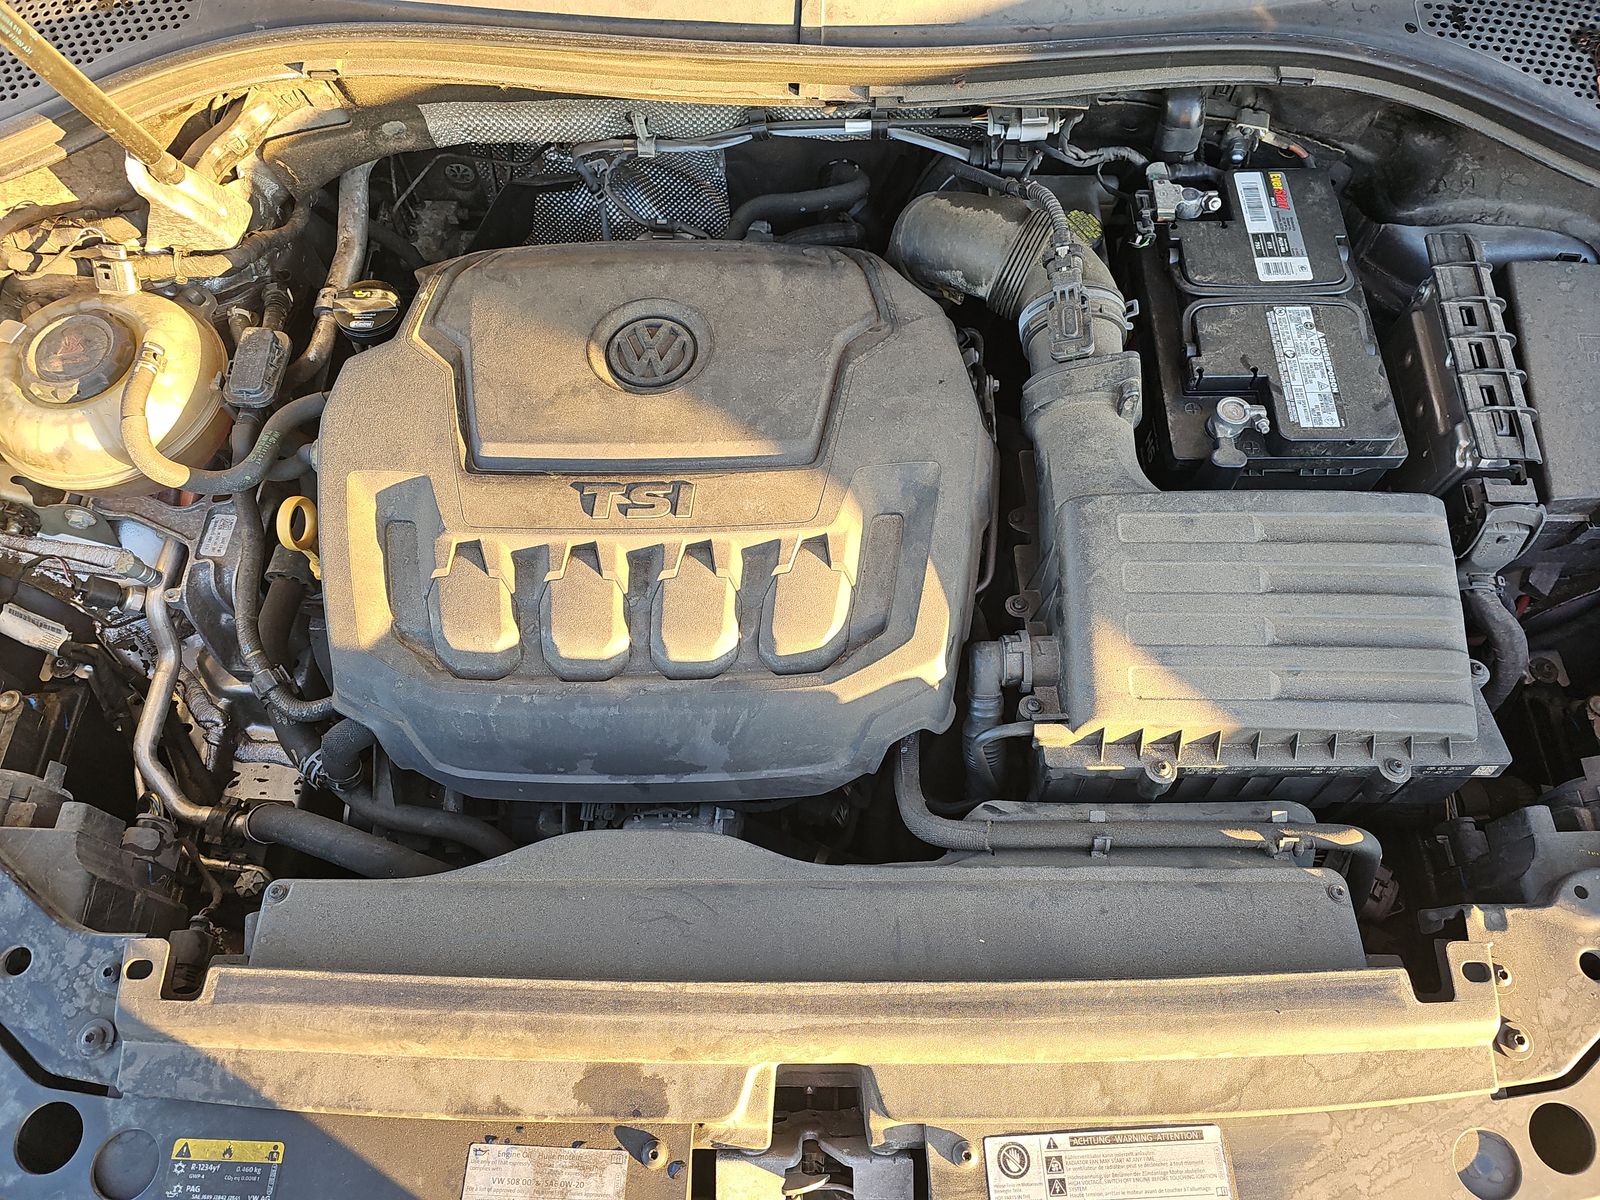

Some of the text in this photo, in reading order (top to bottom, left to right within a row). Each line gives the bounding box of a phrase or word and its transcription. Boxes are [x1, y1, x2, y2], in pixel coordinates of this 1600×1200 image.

[1269, 173, 1290, 210] EverStart
[571, 480, 696, 519] TSI
[1072, 1131, 1198, 1146] ACHTUNG WARNING ATTENTION
[498, 1151, 520, 1160] Engine
[191, 1164, 220, 1173] R-1234yf
